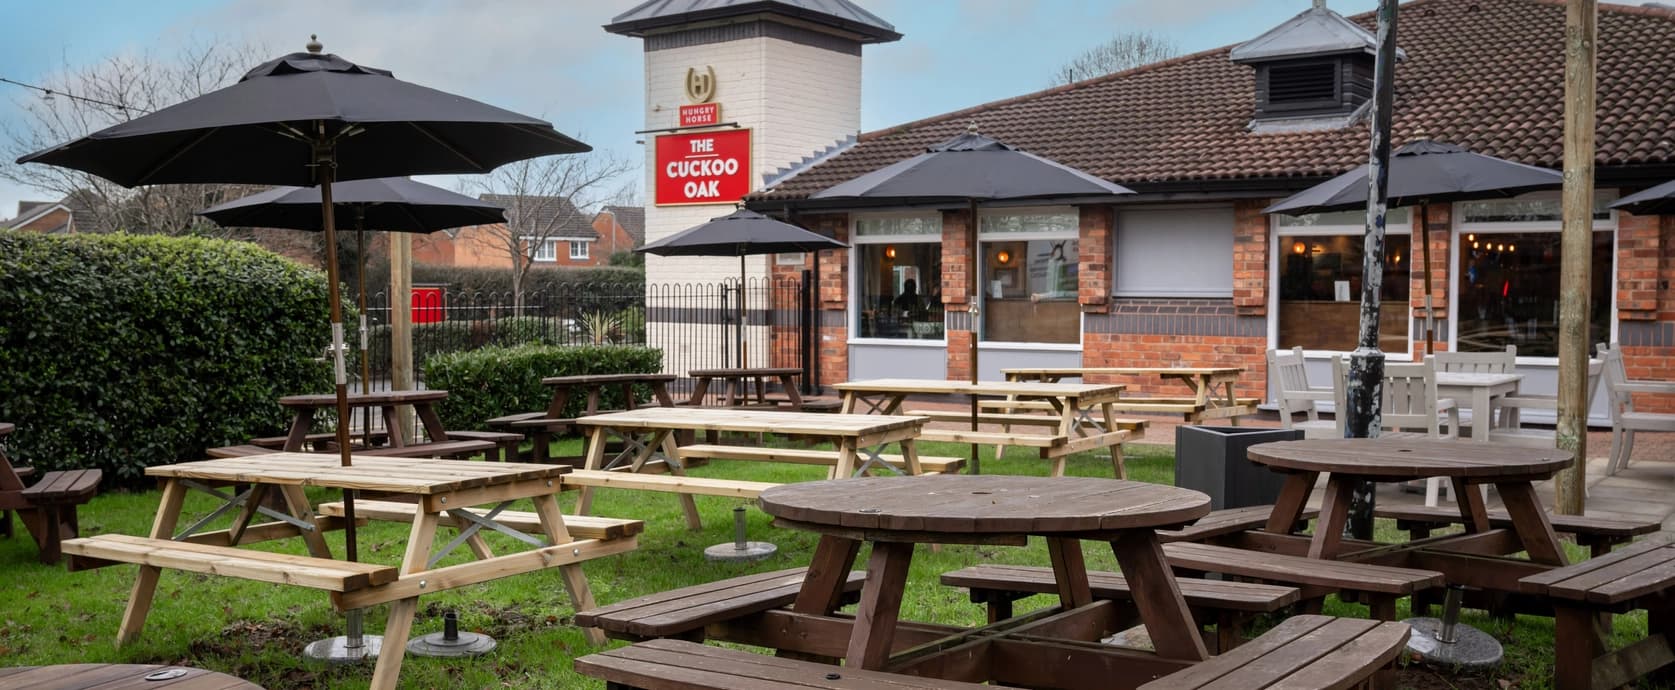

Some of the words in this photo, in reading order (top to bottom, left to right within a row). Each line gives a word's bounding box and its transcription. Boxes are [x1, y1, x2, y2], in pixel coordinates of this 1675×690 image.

[682, 106, 715, 116] HUNGRY
[685, 114, 712, 123] HORSE
[690, 139, 714, 153] THE
[666, 158, 739, 178] CUCKOO
[684, 180, 720, 198] OAK
